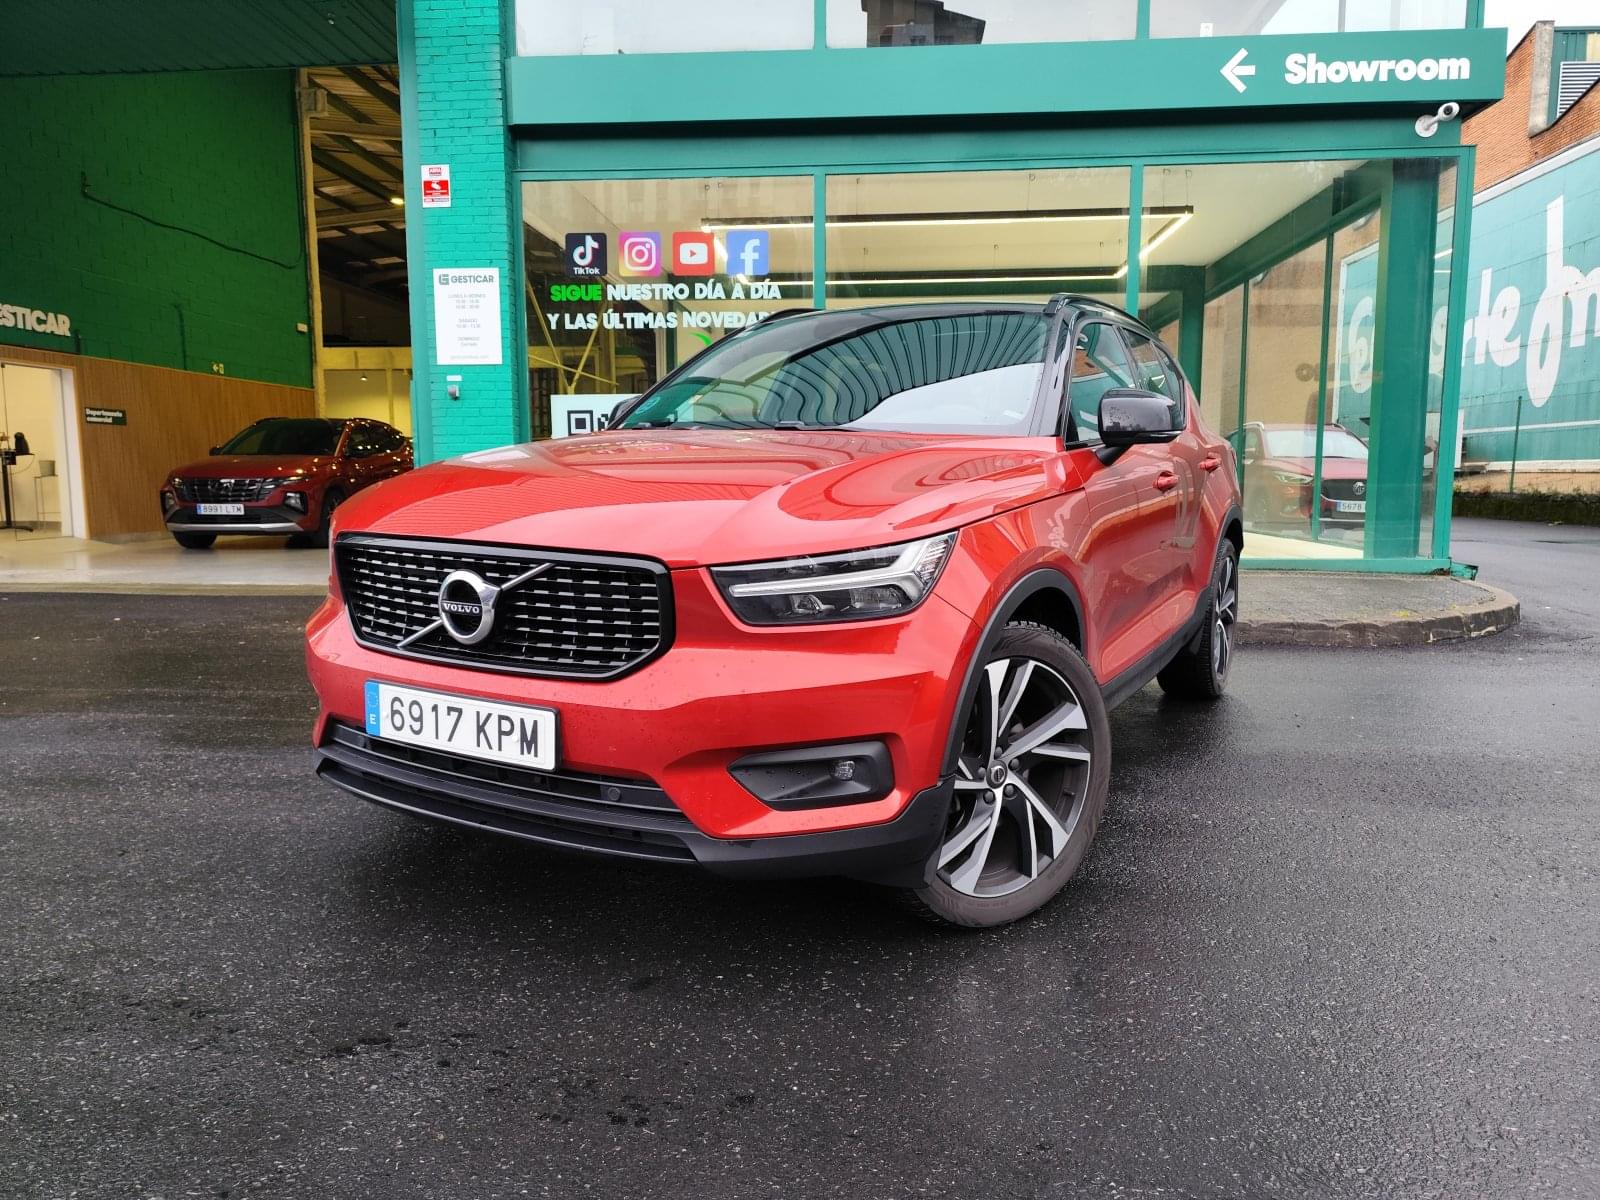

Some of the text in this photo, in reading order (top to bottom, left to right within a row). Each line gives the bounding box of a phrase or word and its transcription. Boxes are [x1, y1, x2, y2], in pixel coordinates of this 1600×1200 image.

[1284, 52, 1471, 85] Showroom
[450, 275, 494, 284] GESTICAR
[573, 266, 601, 276] TikTok
[550, 278, 782, 302] SIGUE NUESTRO DÍA A DÍA
[546, 313, 560, 330] Y
[564, 312, 598, 330] LAS
[602, 308, 678, 330] ÚLTIMAS
[443, 603, 480, 614] VOLVO
[390, 696, 464, 742] 6917
[475, 710, 539, 758] KPM
